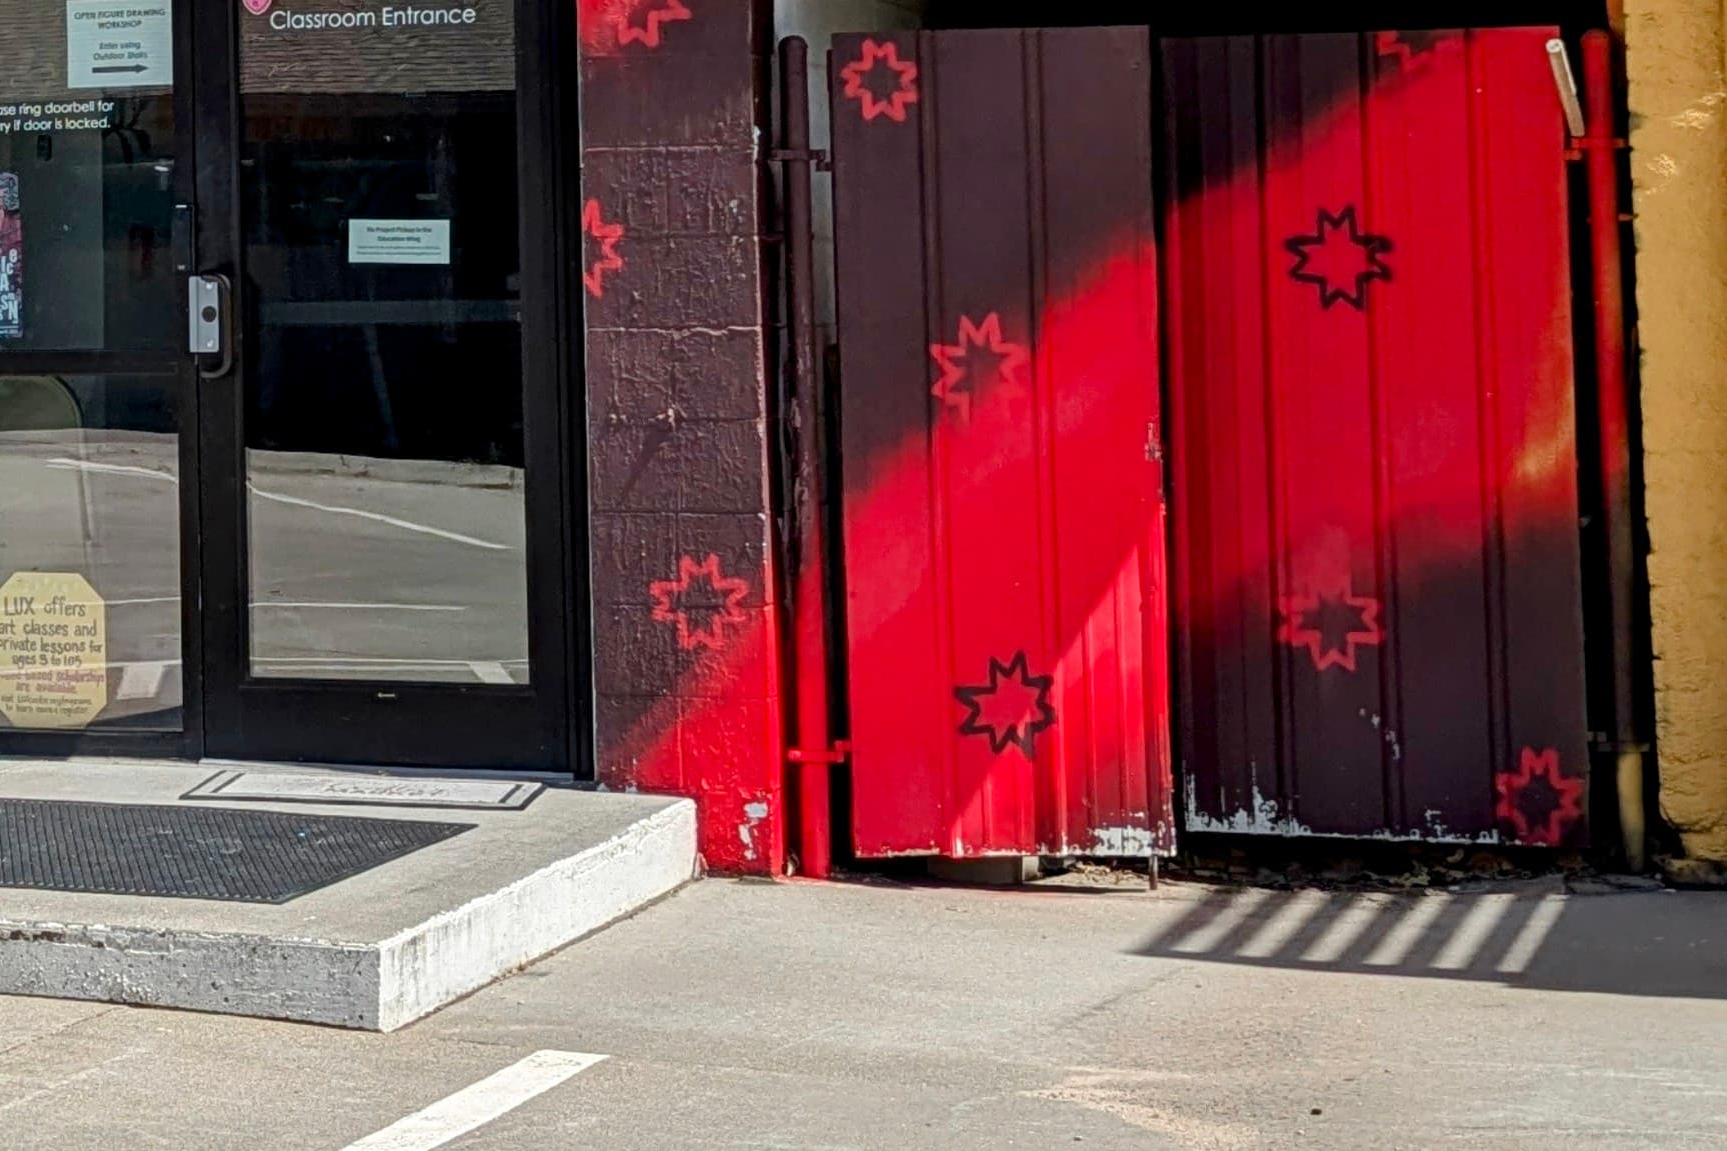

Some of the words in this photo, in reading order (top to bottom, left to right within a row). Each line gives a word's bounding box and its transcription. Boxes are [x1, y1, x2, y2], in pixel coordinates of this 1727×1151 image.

[74, 12, 96, 20] OPEN
[97, 10, 124, 19] FIGURE
[126, 8, 166, 17] DRAWING
[270, 10, 375, 30] Classroom
[382, 6, 477, 26] Entrance
[98, 20, 142, 29] WORKSHOP
[19, 103, 41, 117] ring
[44, 101, 95, 114] doorbell
[97, 100, 114, 112] for
[14, 119, 21, 131] if
[23, 119, 52, 131] door
[54, 117, 63, 130] is
[65, 116, 111, 129] locked.
[4, 597, 35, 616] LUX
[44, 595, 86, 616] offers
[23, 619, 69, 636] classes
[74, 618, 97, 636] and
[40, 637, 85, 654] lessons
[89, 640, 103, 653] for
[12, 655, 36, 669] ages
[50, 655, 61, 666] to
[63, 655, 83, 667] 105
